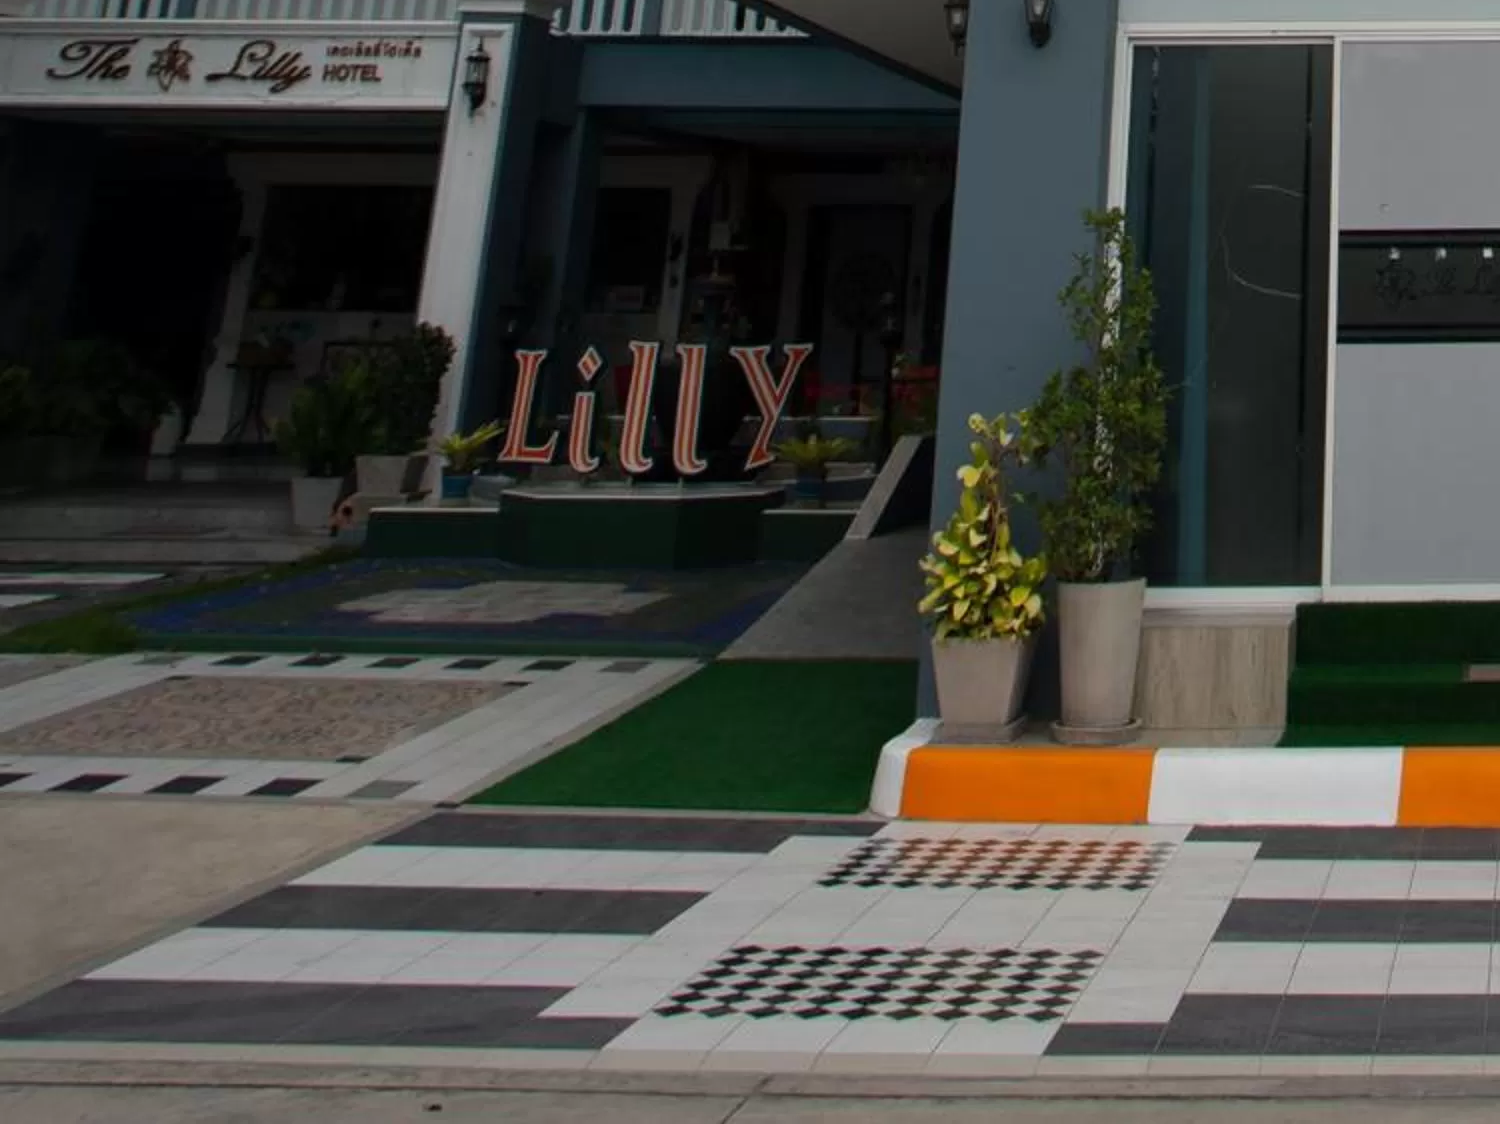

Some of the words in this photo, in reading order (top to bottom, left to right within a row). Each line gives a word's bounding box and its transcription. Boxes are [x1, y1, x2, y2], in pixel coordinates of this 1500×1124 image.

[45, 37, 140, 81] The
[204, 38, 314, 94] Lilly
[321, 63, 382, 83] HOTEL
